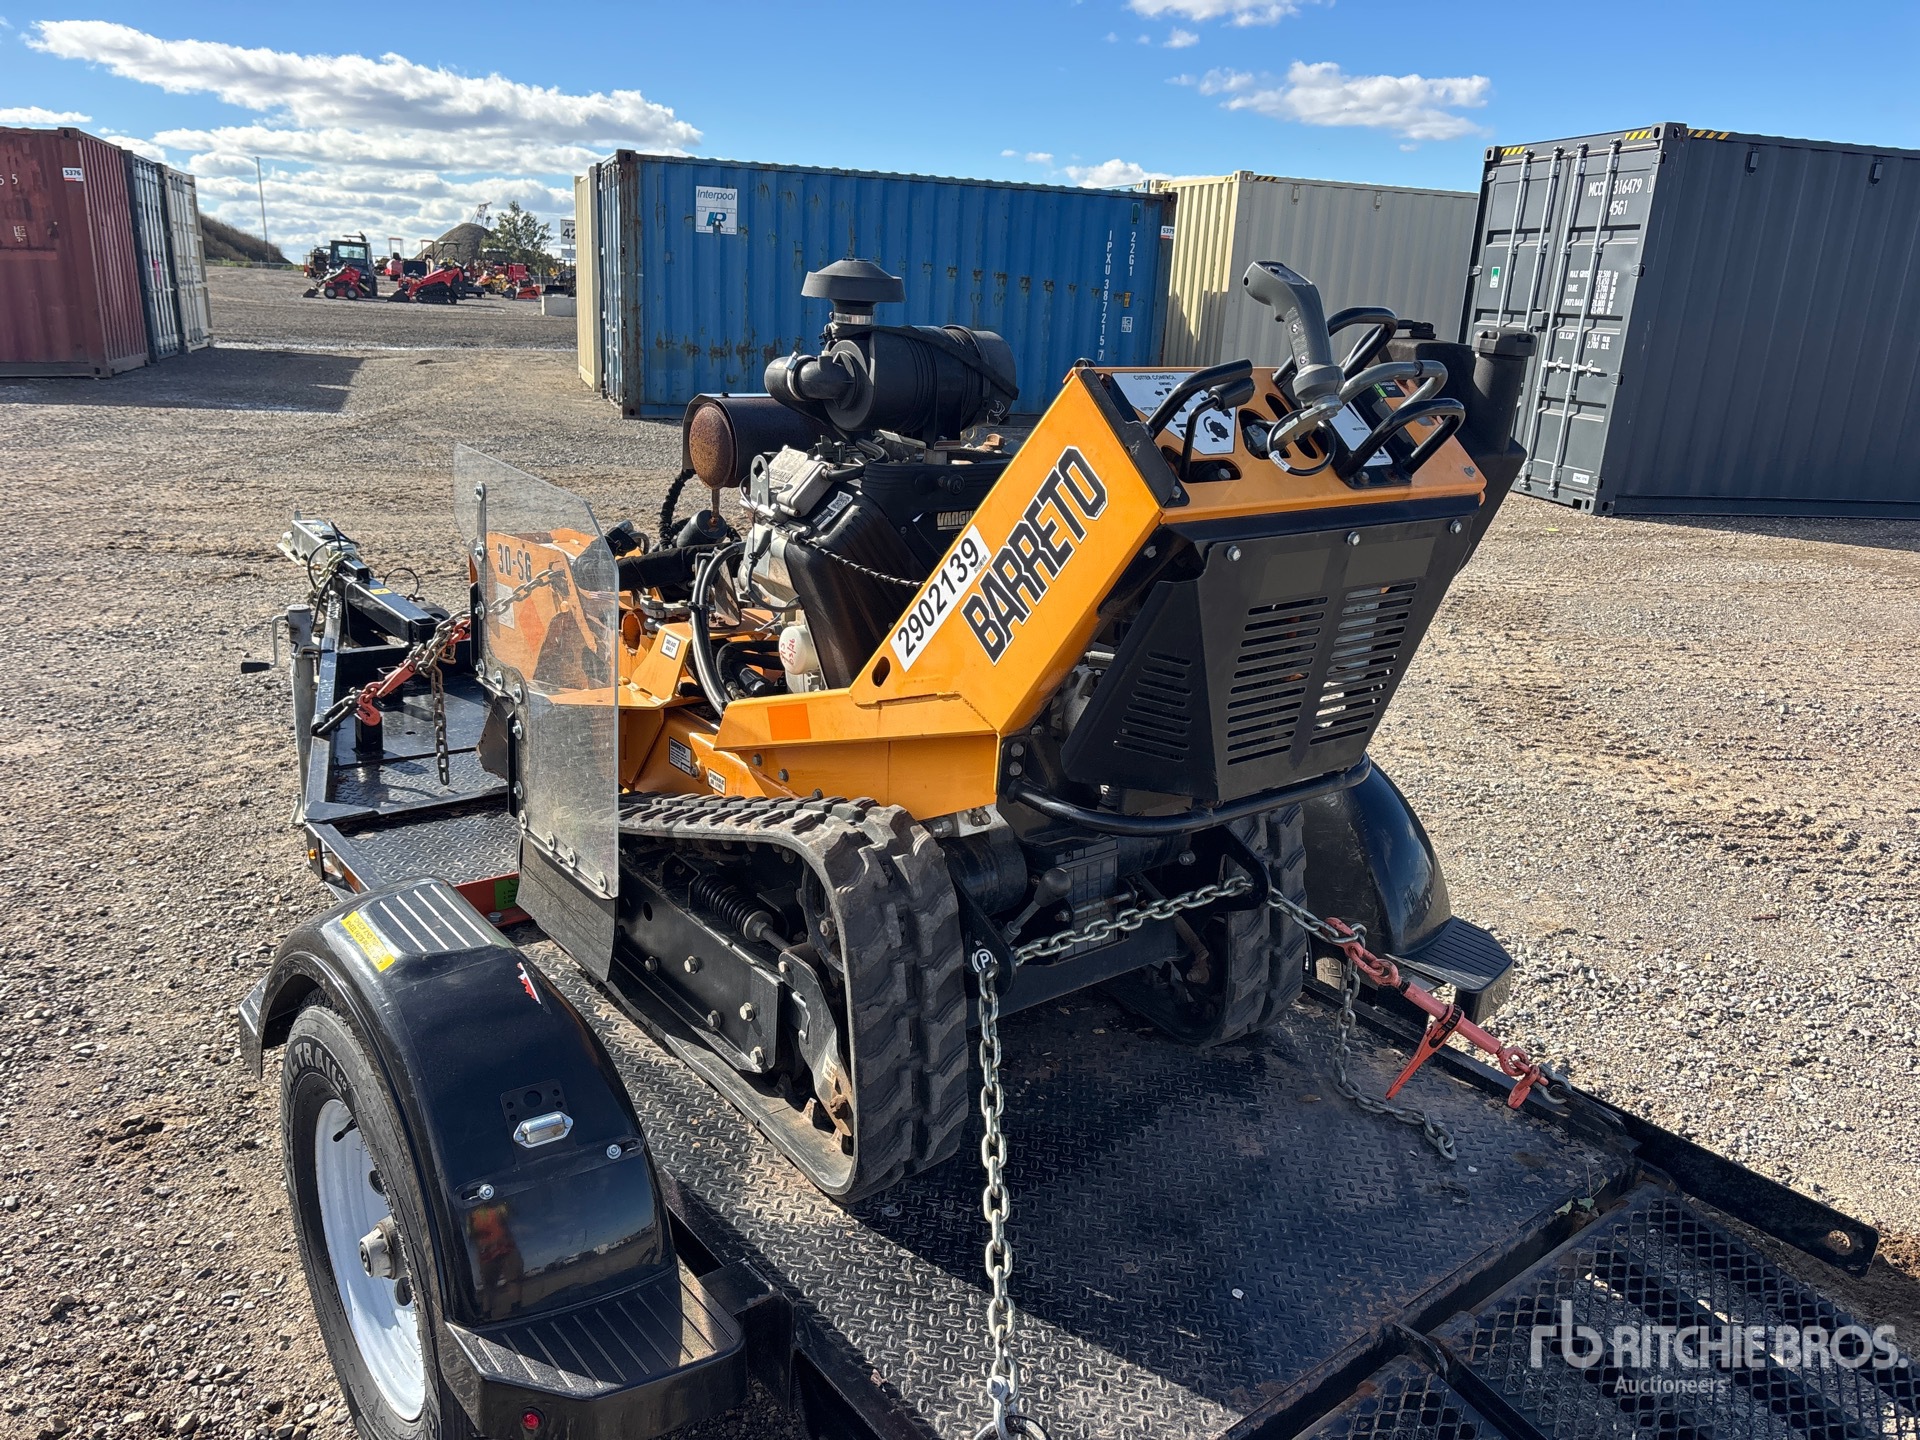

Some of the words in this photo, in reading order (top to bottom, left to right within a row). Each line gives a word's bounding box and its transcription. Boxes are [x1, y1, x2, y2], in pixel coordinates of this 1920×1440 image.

[697, 189, 736, 201] Interpool
[1609, 200, 1628, 215] 45G1
[1613, 178, 1643, 195] 316479
[1104, 230, 1113, 275] IPXU
[1128, 231, 1136, 276] 22G1
[497, 543, 532, 583] 30-SG
[961, 446, 1109, 666] BARRETO
[898, 537, 979, 658] 2902139
